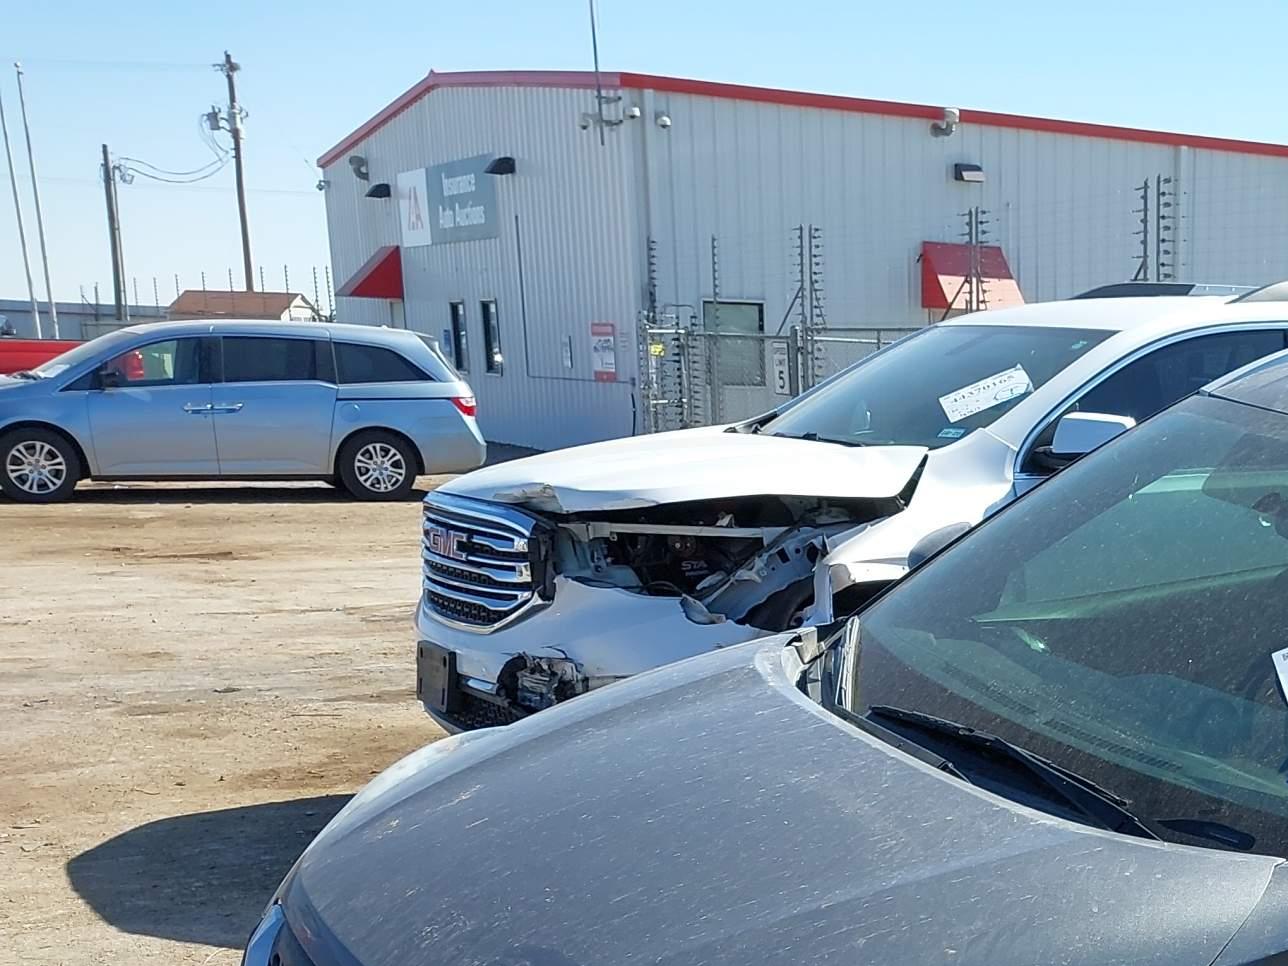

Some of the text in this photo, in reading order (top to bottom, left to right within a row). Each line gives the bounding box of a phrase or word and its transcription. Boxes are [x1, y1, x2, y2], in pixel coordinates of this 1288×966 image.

[441, 172, 476, 197] Insurance
[439, 201, 486, 229] Auto Auctions
[778, 370, 786, 390] 5
[429, 526, 467, 562] GMC
